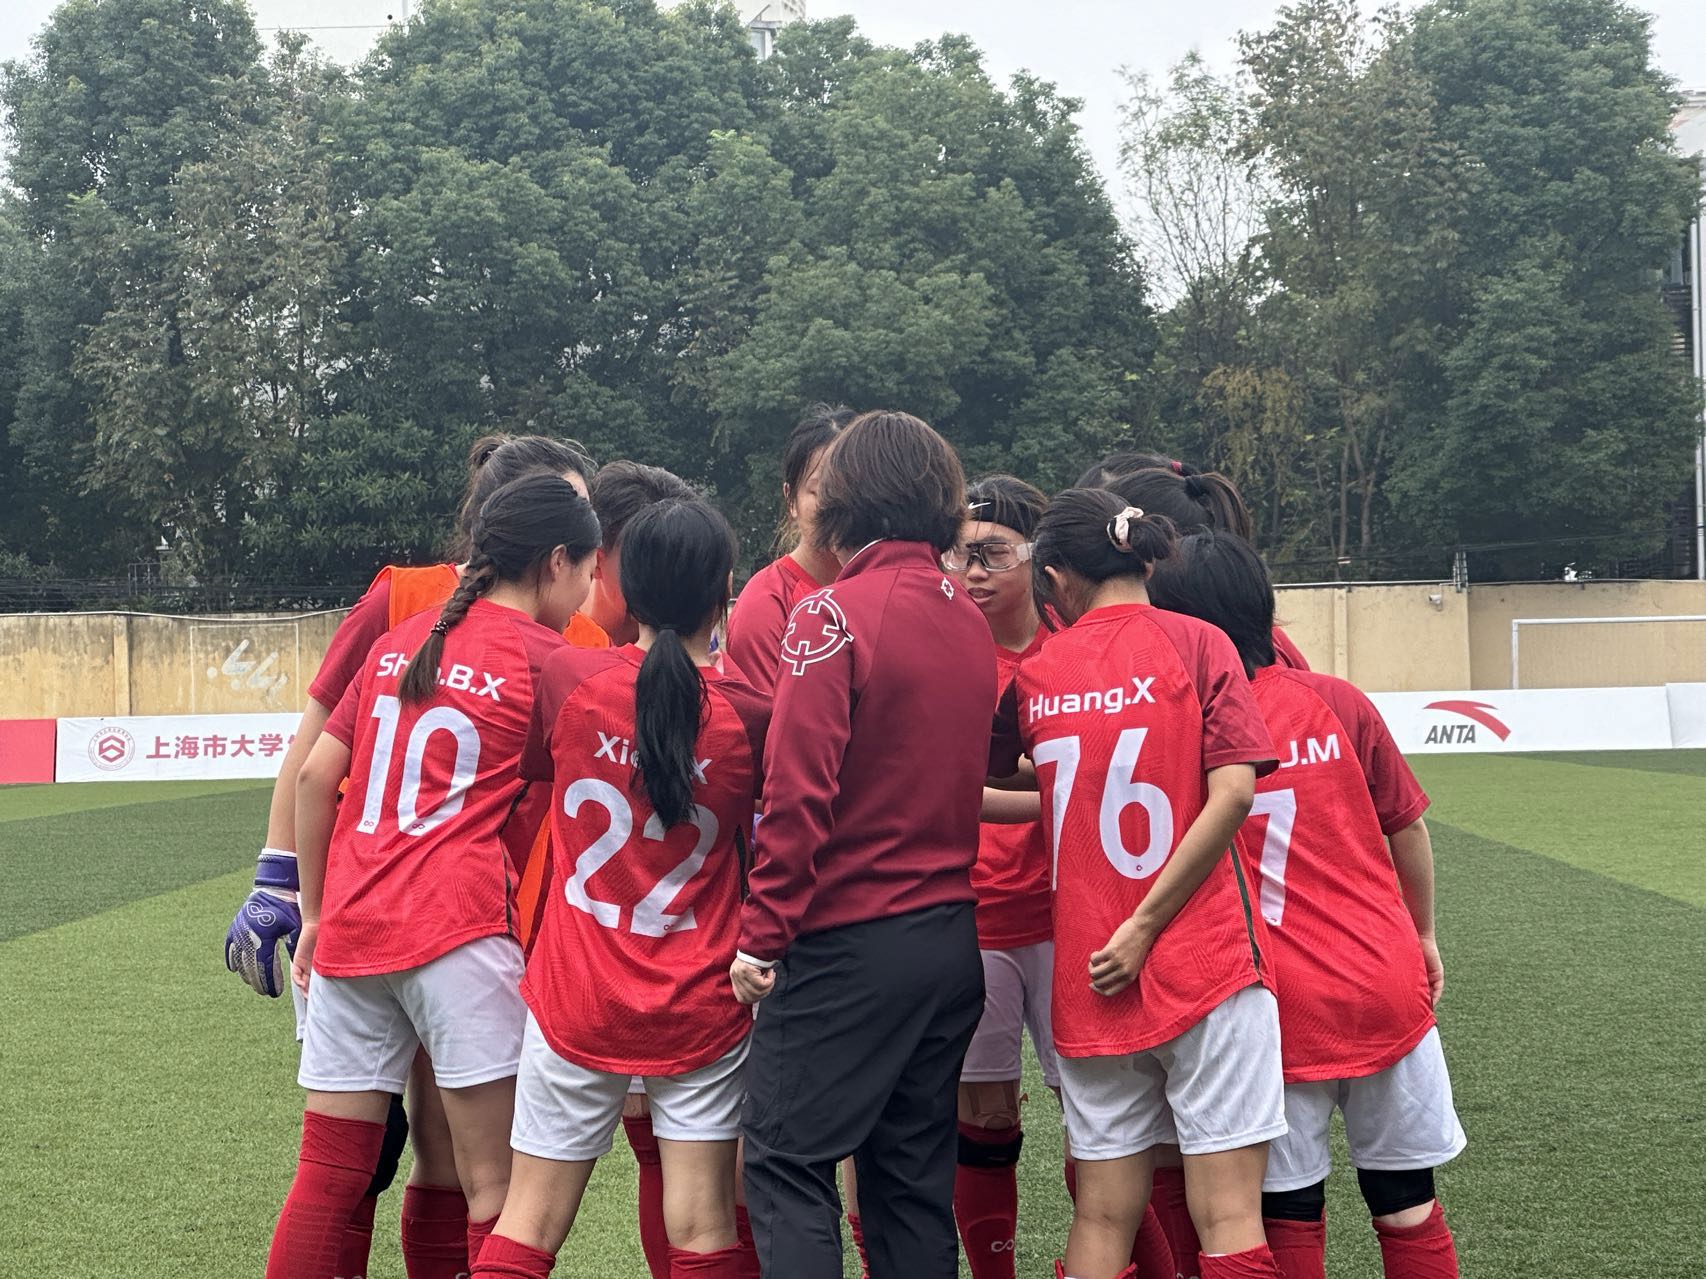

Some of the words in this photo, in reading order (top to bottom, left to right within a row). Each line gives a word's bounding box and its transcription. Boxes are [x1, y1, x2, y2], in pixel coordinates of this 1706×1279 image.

[376, 652, 507, 702] Sh.B.X
[1029, 676, 1156, 724] Huang.X
[145, 733, 297, 760] 上海市大学
[1279, 733, 1341, 769] J.M
[1424, 724, 1477, 744] ANTA
[356, 694, 481, 837] 10
[1032, 727, 1174, 891] 76
[563, 778, 719, 938] 22
